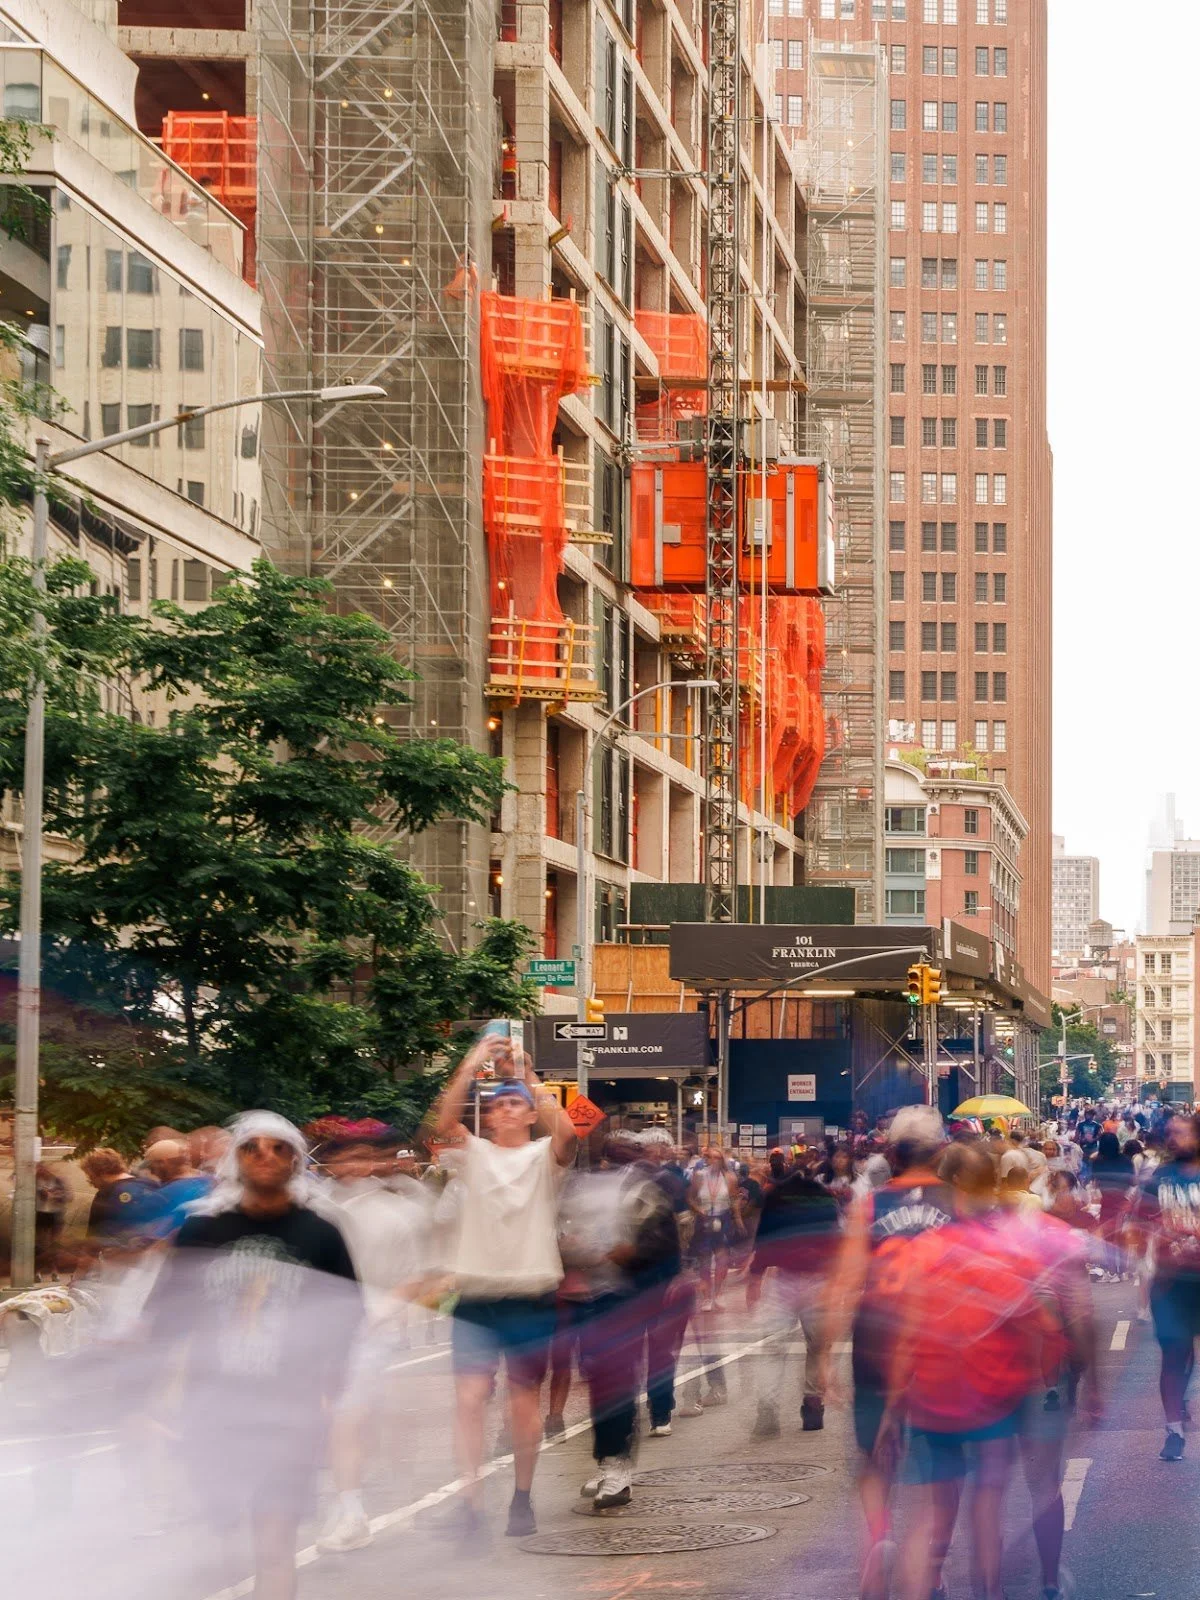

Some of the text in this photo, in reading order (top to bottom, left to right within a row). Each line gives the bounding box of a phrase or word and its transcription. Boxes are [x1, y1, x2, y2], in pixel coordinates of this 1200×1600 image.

[795, 936, 813, 945] 101
[772, 948, 836, 958] FRANKLIN
[534, 962, 565, 972] Leonard
